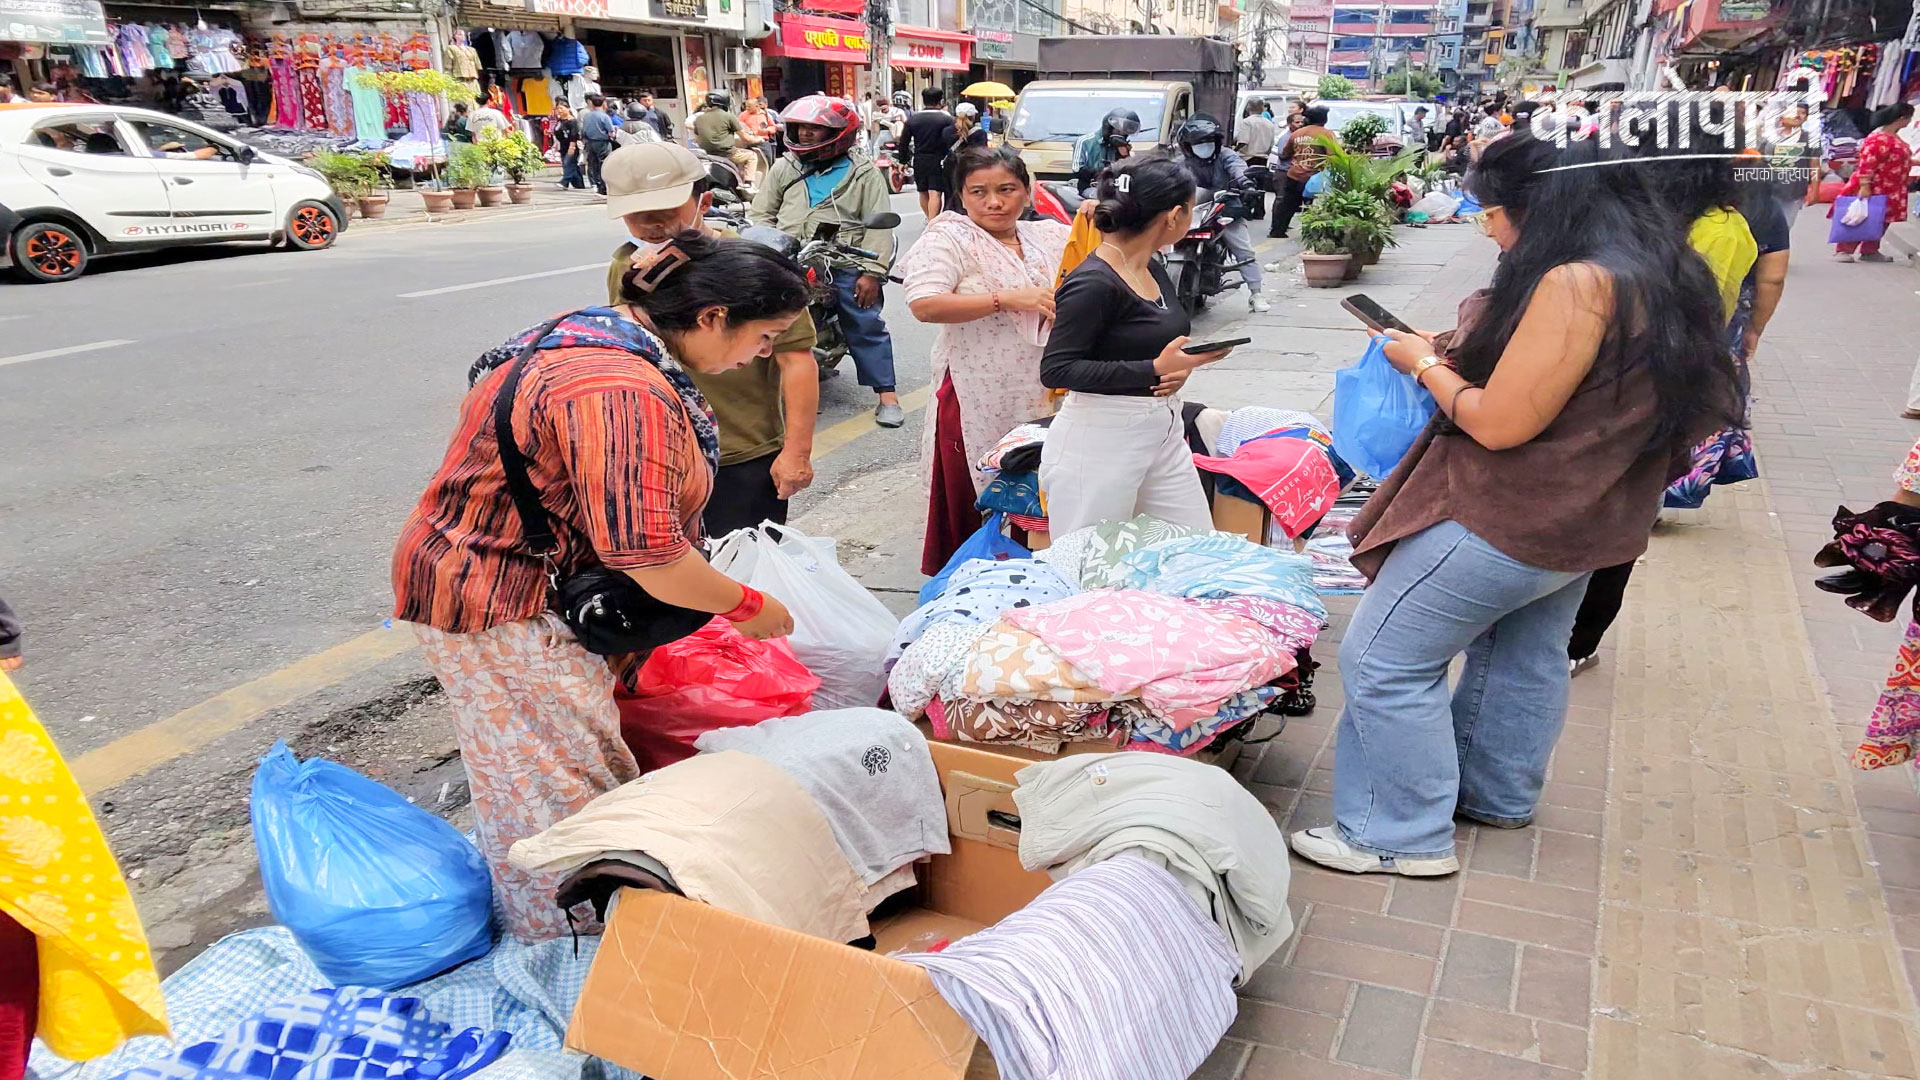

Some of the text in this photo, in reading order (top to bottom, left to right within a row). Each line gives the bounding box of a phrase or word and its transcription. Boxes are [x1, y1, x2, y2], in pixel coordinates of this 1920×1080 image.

[666, 2, 697, 16] SWEETS
[804, 29, 838, 49] पशुपति
[146, 223, 228, 235] HYUNDAI
[1265, 477, 1302, 505] MEMBER
